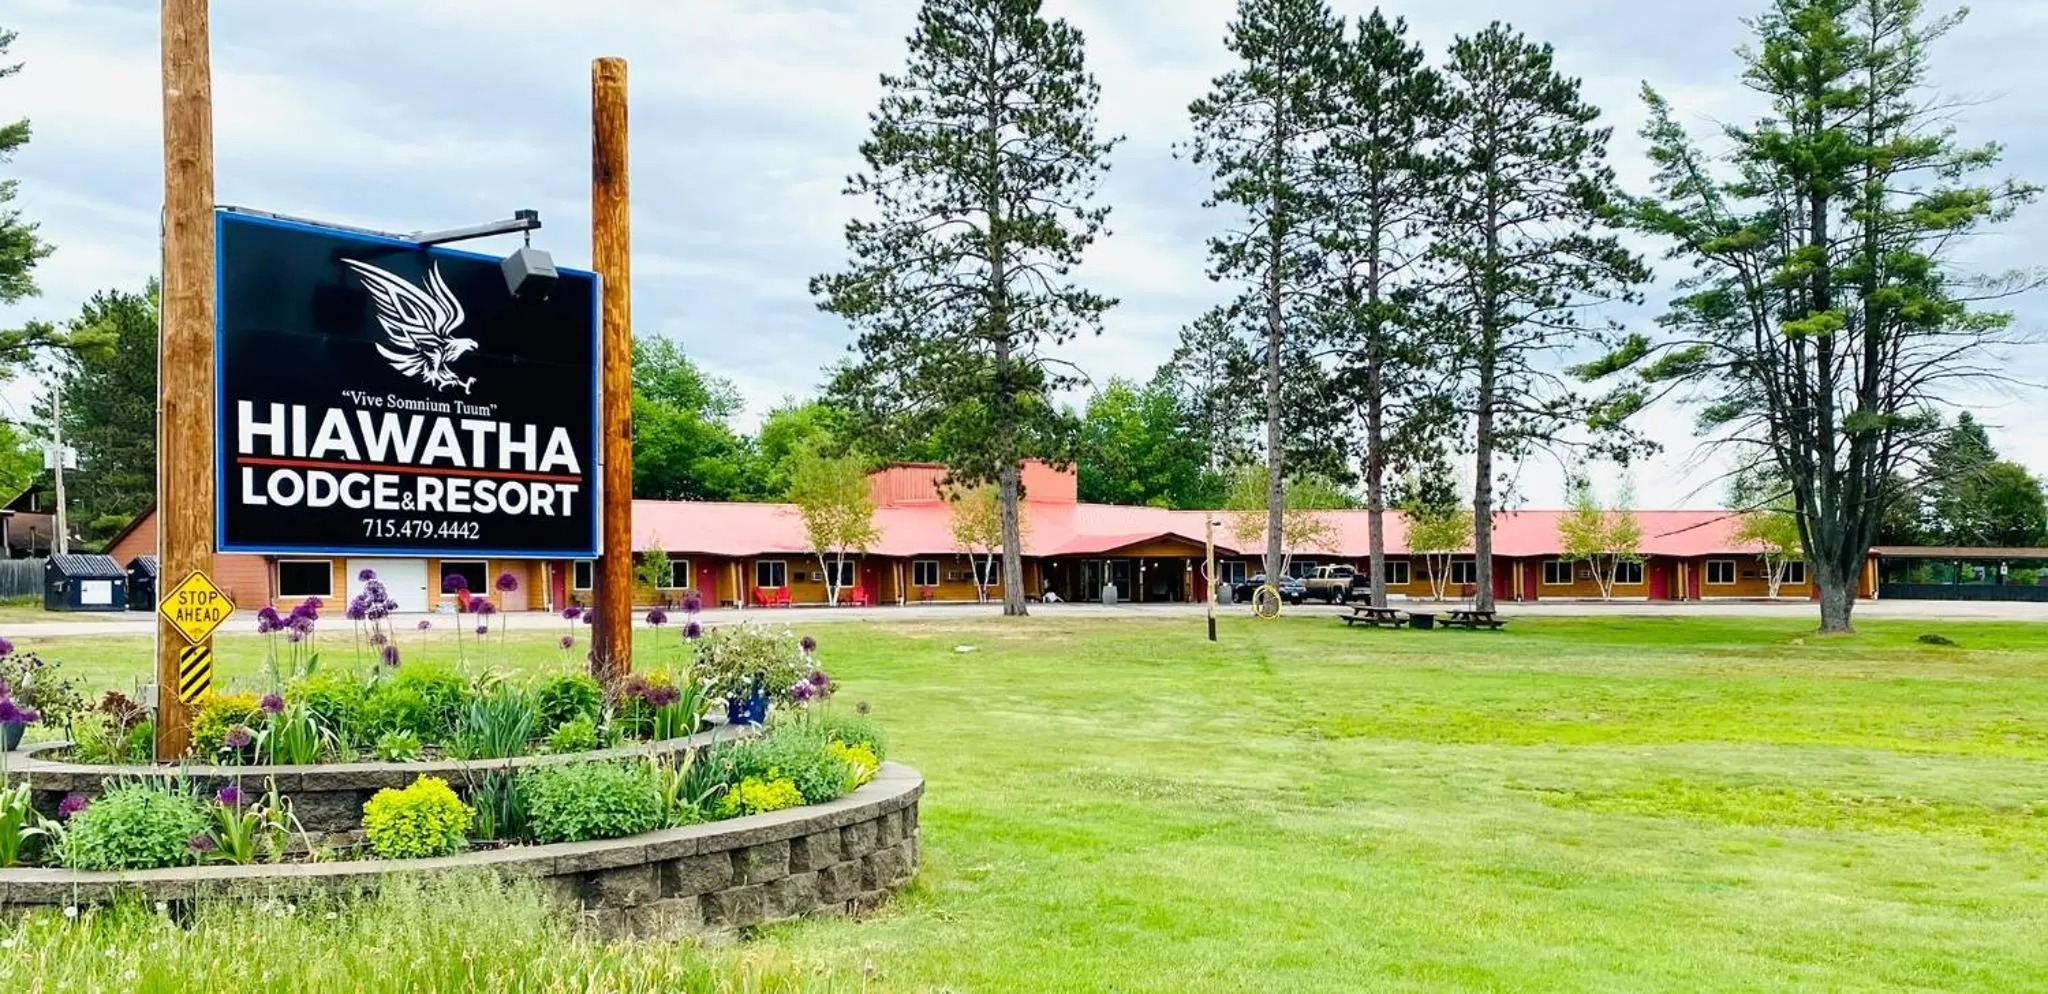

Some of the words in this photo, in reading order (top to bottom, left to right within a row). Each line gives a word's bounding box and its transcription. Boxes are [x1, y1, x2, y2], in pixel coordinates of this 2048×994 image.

[387, 393, 450, 412] Somnium
[238, 400, 581, 474] HIAWATHA
[363, 518, 480, 540] 715.479.4442
[179, 590, 218, 605] STOP
[176, 608, 220, 622] AHEAD
